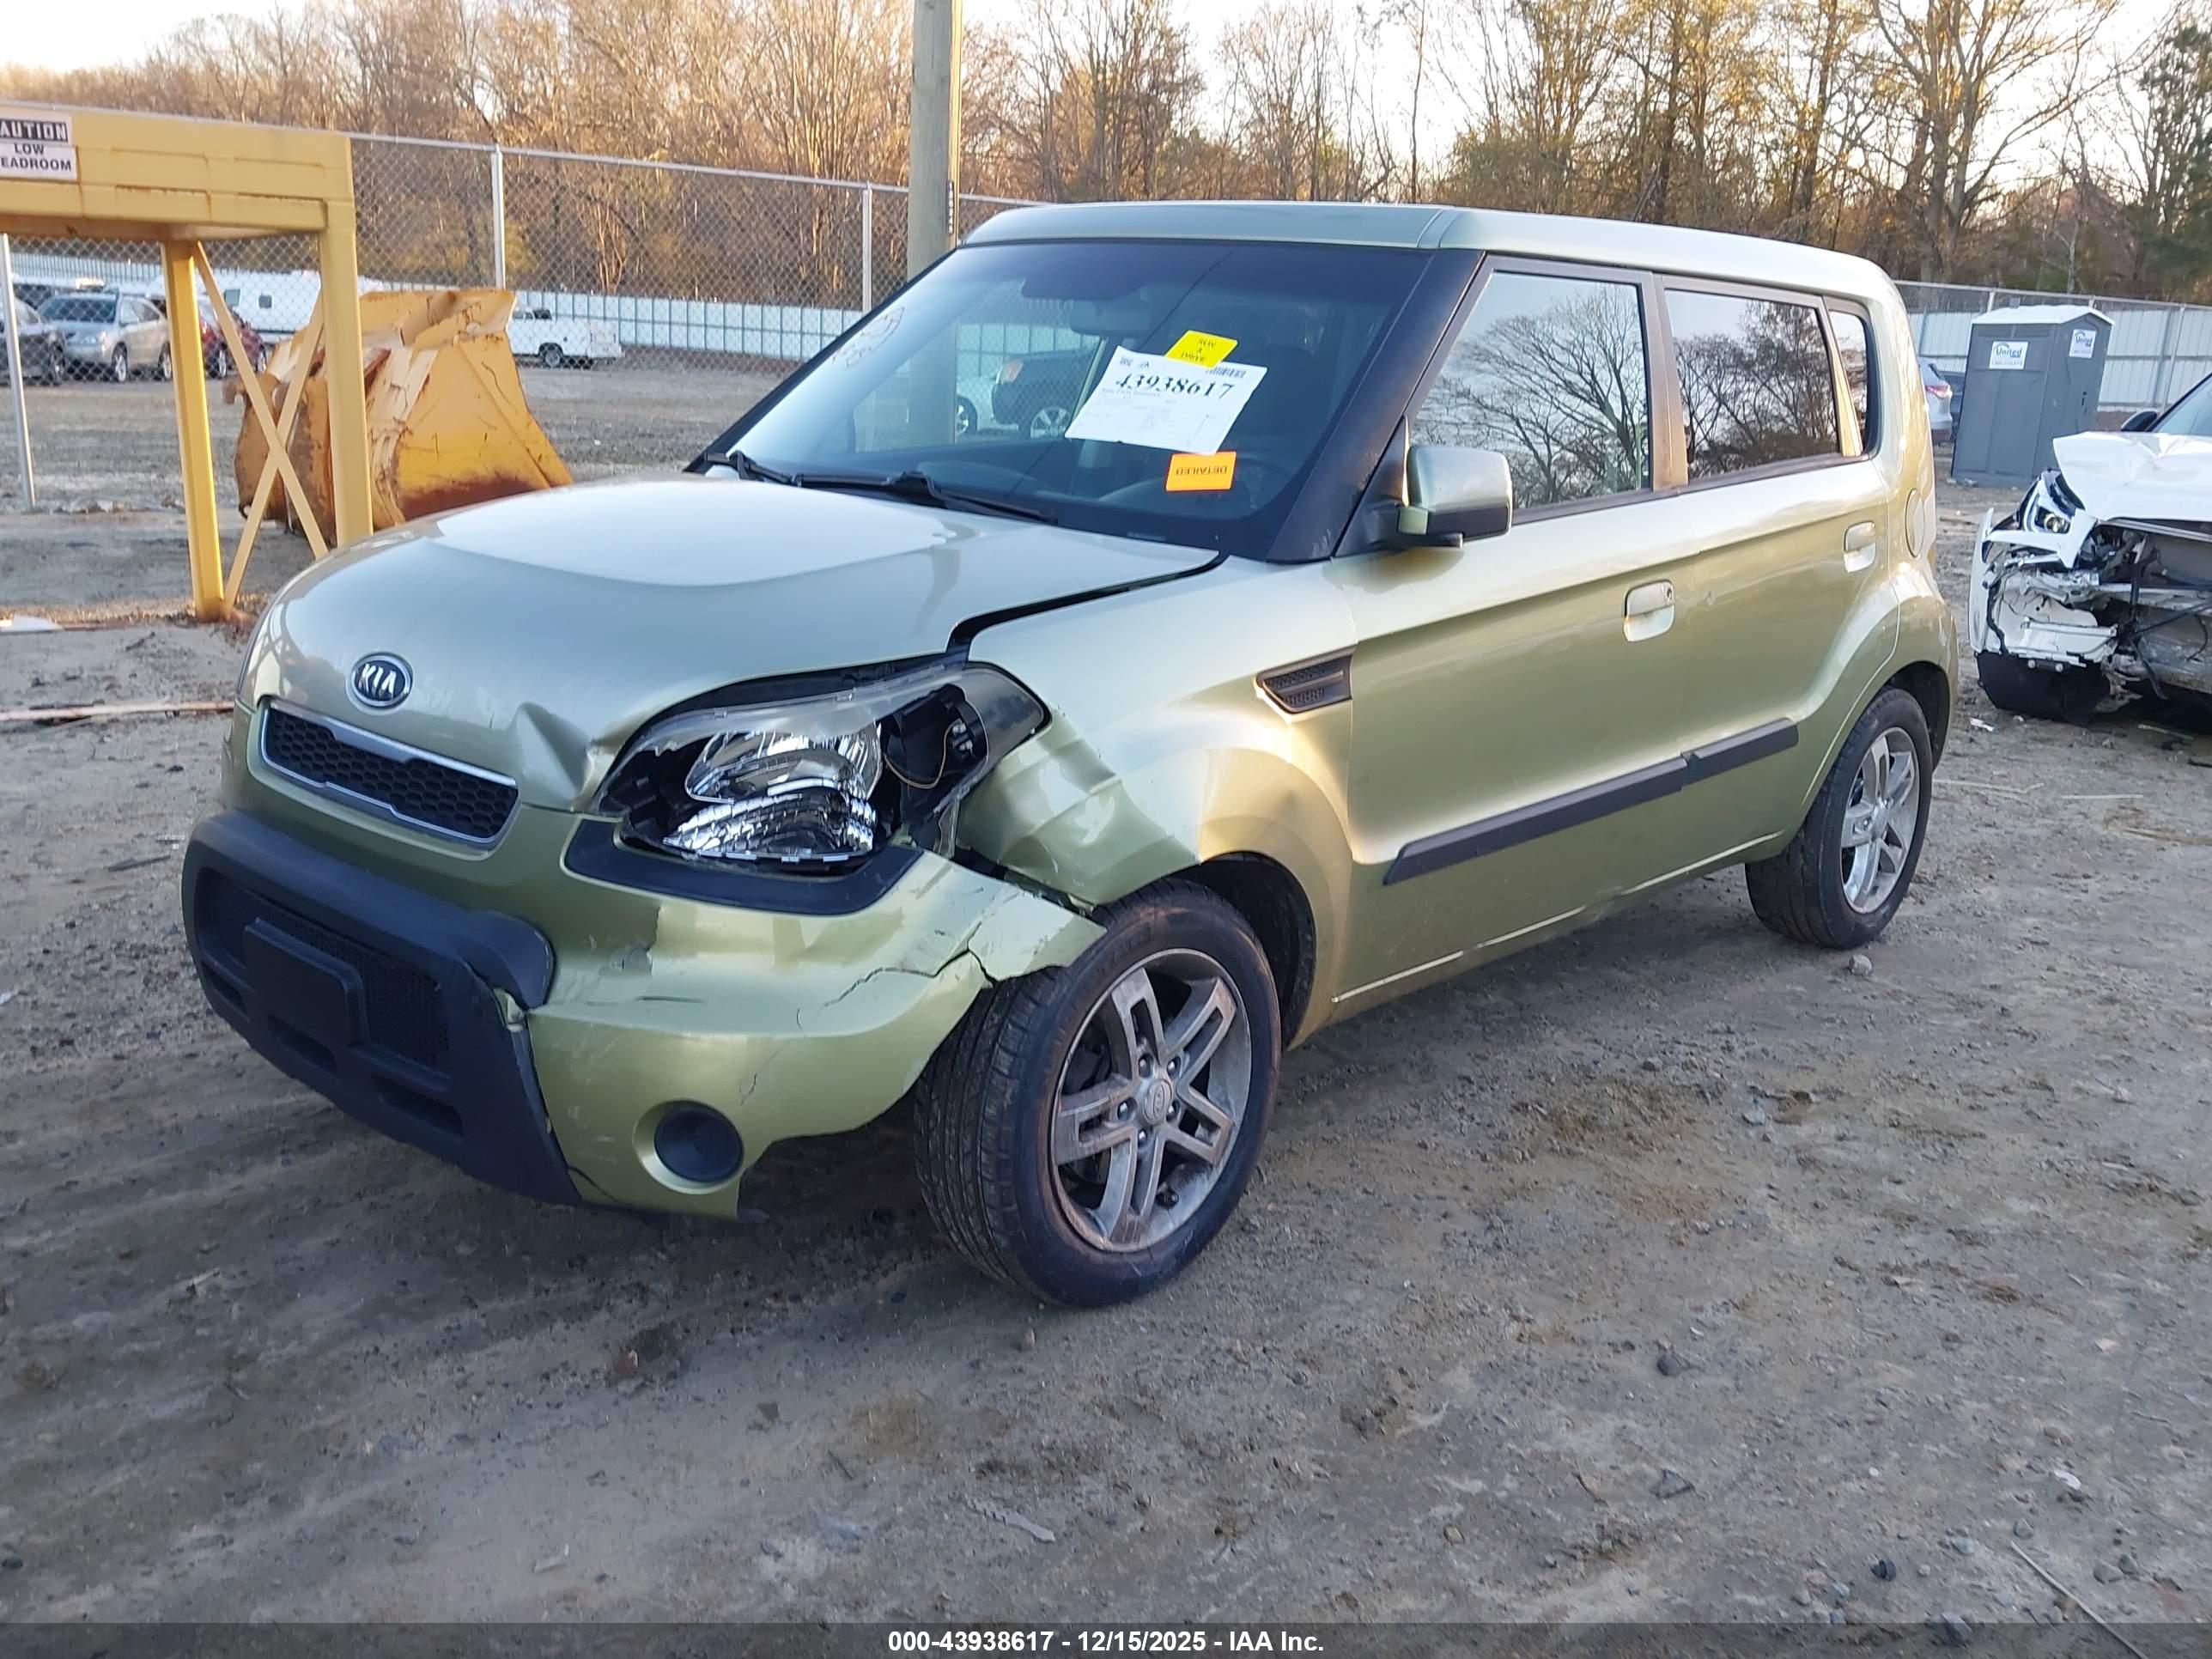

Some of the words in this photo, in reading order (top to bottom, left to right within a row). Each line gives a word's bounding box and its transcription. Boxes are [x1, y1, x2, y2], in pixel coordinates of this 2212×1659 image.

[14, 143, 45, 155] LOW
[1995, 347, 2022, 357] United
[1115, 373, 1236, 399] 43938617
[1176, 465, 1228, 476] DETAILED
[357, 663, 397, 699] KIA
